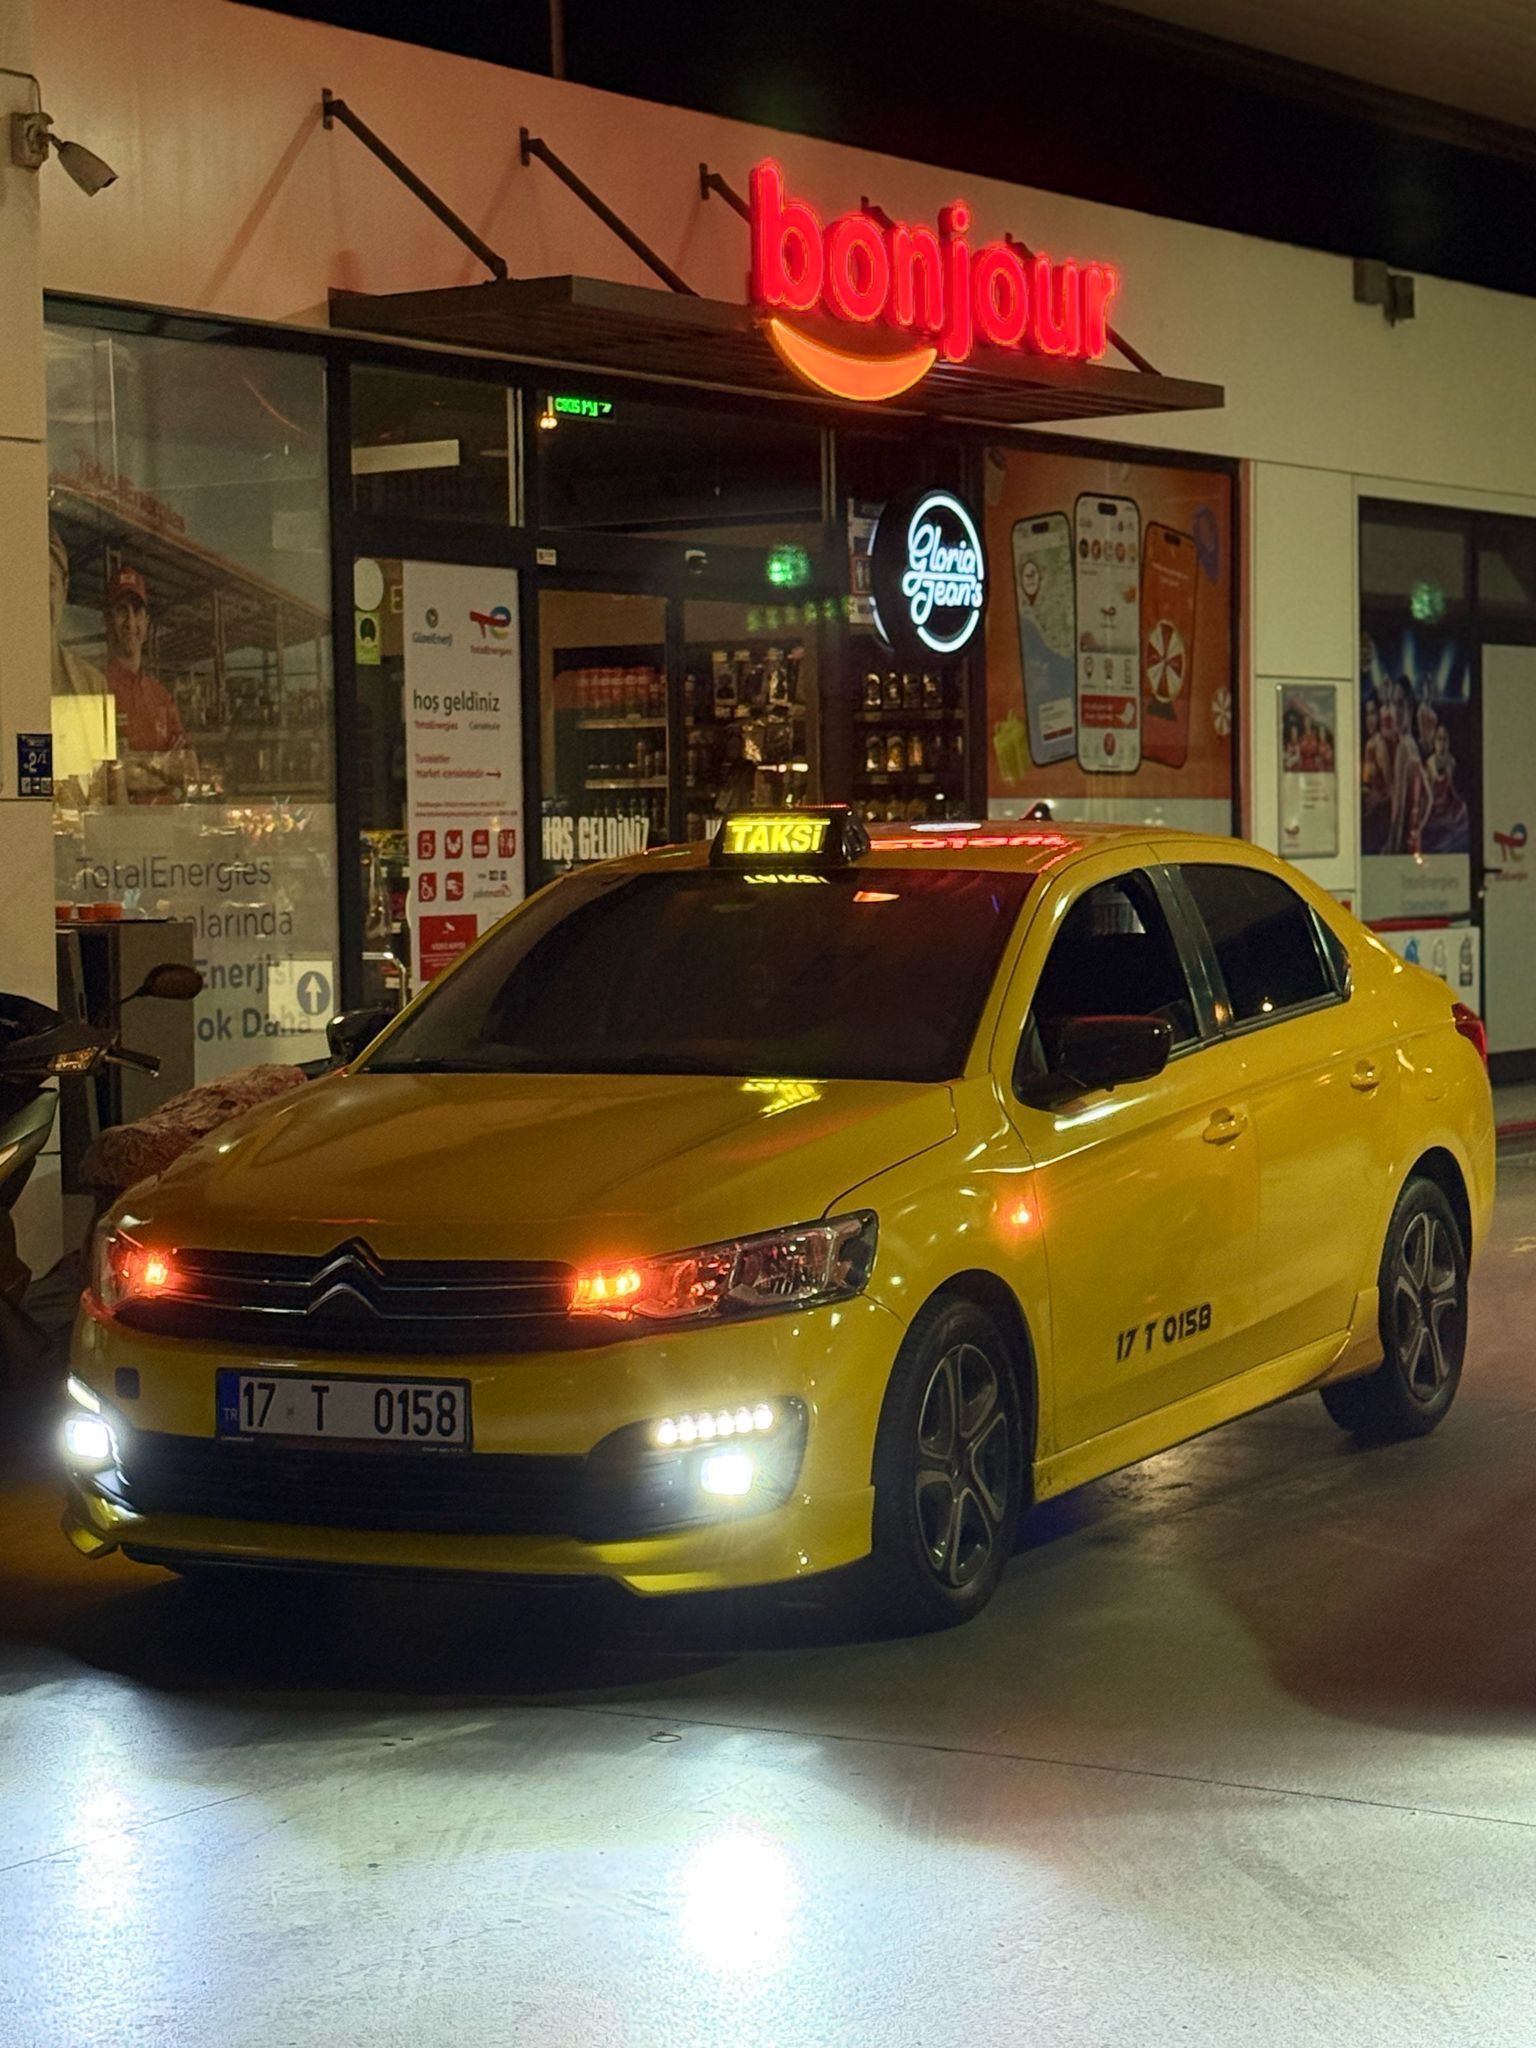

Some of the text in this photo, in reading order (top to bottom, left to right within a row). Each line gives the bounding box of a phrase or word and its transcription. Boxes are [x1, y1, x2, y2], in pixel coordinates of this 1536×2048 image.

[750, 159, 1119, 363] bonjour
[902, 523, 976, 597] Gloria
[911, 578, 983, 625] Jean's
[413, 689, 500, 716] hoş geldiniz
[542, 816, 574, 869] HOŞ
[76, 855, 272, 892] TotalEnergies
[167, 905, 293, 938] nlarında
[1116, 1328, 1139, 1362] 17
[1145, 1321, 1158, 1352] T
[223, 1407, 239, 1422] TR
[243, 1381, 457, 1437] 17 T 0158
